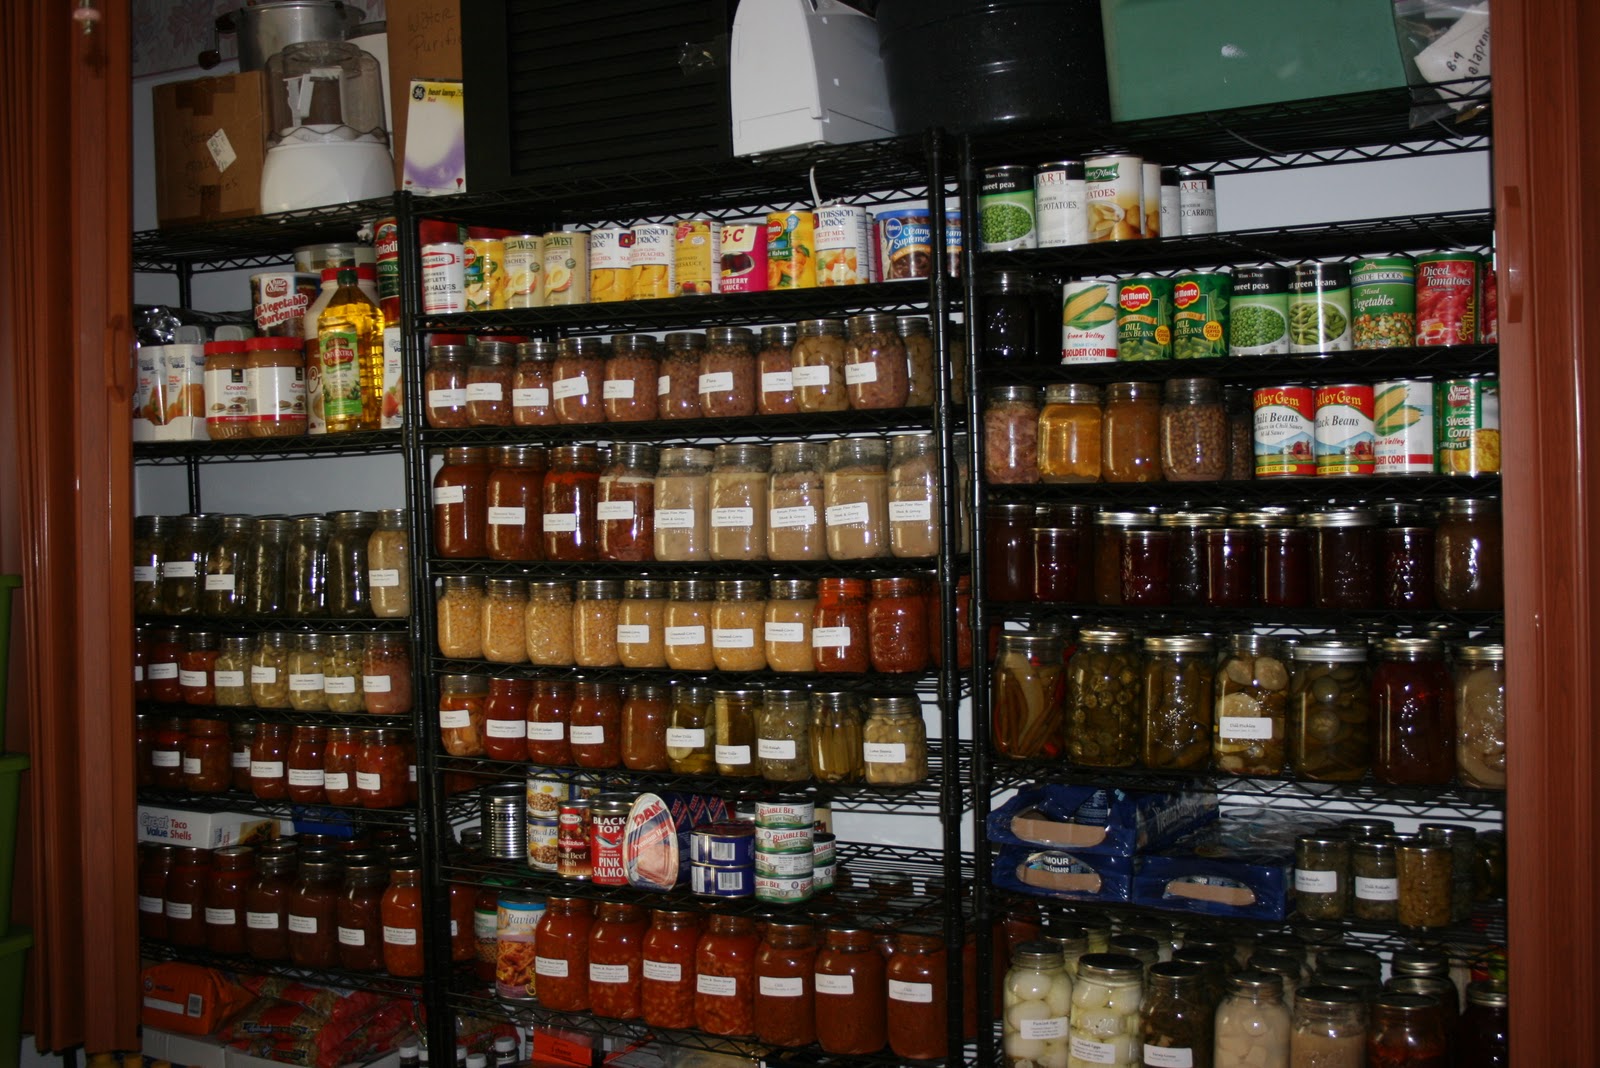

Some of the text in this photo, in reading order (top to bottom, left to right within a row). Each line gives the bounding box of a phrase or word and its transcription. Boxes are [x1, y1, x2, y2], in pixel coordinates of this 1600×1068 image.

[428, 88, 456, 99] heat lamp
[1000, 181, 1016, 191] peas
[1186, 209, 1214, 217] CARROTS
[722, 229, 744, 243] 3-C
[517, 241, 537, 250] WEST
[554, 237, 573, 246] WEST
[894, 236, 927, 249] Supreme
[1377, 271, 1404, 281] FOODS
[1423, 265, 1451, 277] Diced
[1234, 282, 1270, 291] sweet peas
[1294, 281, 1313, 290] green
[1427, 276, 1472, 287] Tomatoes
[1180, 289, 1197, 297] Monte
[1354, 295, 1394, 312] Vegetables
[259, 307, 306, 326] Shortening
[1126, 323, 1141, 331] DILL
[1177, 320, 1189, 328] DILL
[1133, 329, 1153, 337] BEANS
[1183, 326, 1201, 334] BEANS
[1085, 331, 1105, 341] Valley
[1066, 348, 1105, 357] GOLDEN CORN
[1275, 391, 1299, 406] Gem
[1337, 390, 1362, 405] Gem
[1270, 412, 1299, 423] Beans
[1331, 415, 1359, 426] Beans
[1448, 428, 1471, 438] Corn
[1384, 438, 1406, 446] Valley
[1388, 455, 1406, 464] CORN
[760, 807, 782, 815] BUMBLE
[141, 812, 187, 829] Great Taco
[593, 816, 626, 825] BLACK
[146, 827, 192, 841] Value Shells
[598, 825, 620, 833] TOP
[773, 832, 799, 843] BUMBLE
[599, 857, 620, 867] PINK
[594, 867, 626, 877] SALMO
